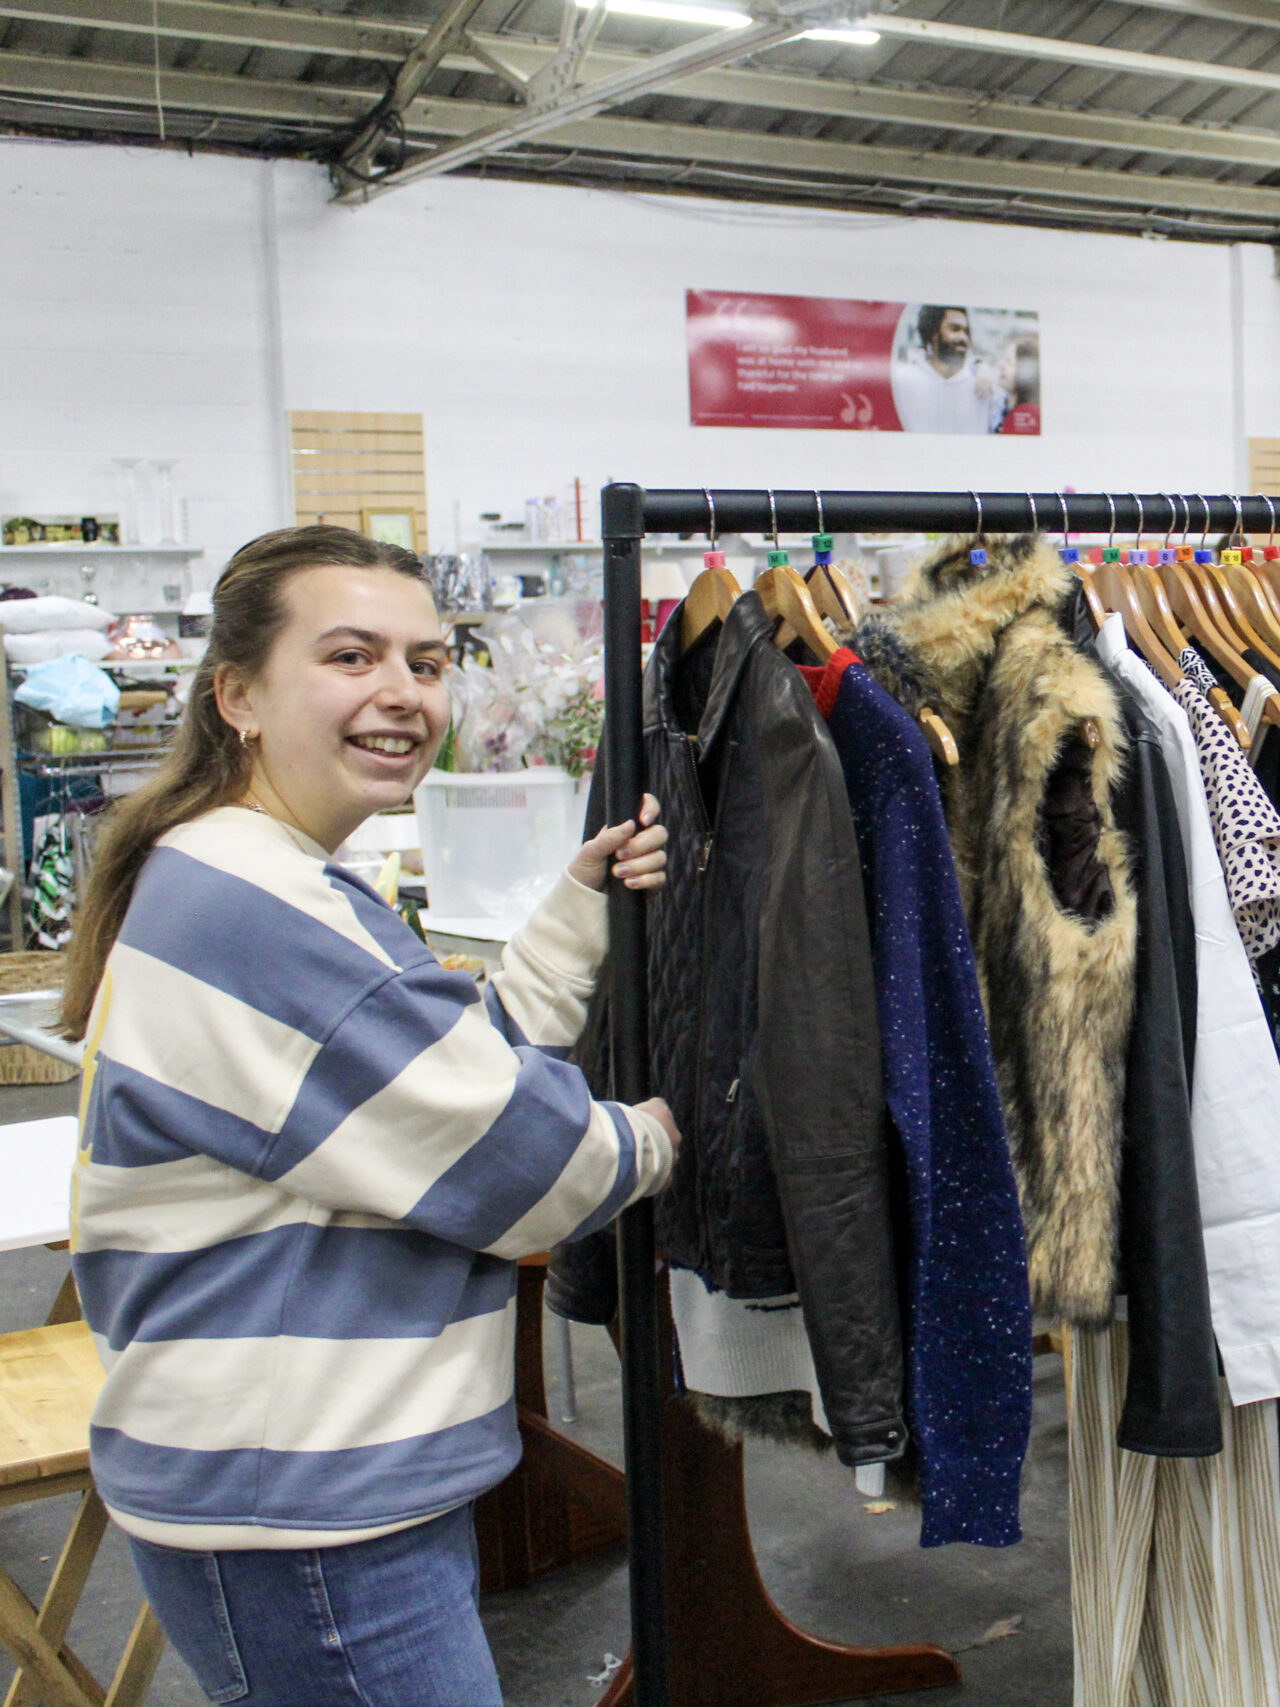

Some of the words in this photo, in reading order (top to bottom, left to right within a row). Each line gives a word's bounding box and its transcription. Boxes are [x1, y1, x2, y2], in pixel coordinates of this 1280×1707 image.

[809, 346, 849, 357] husband
[768, 356, 795, 366] home
[737, 369, 775, 379] thankful
[771, 555, 778, 563] M
[974, 552, 983, 561] 14
